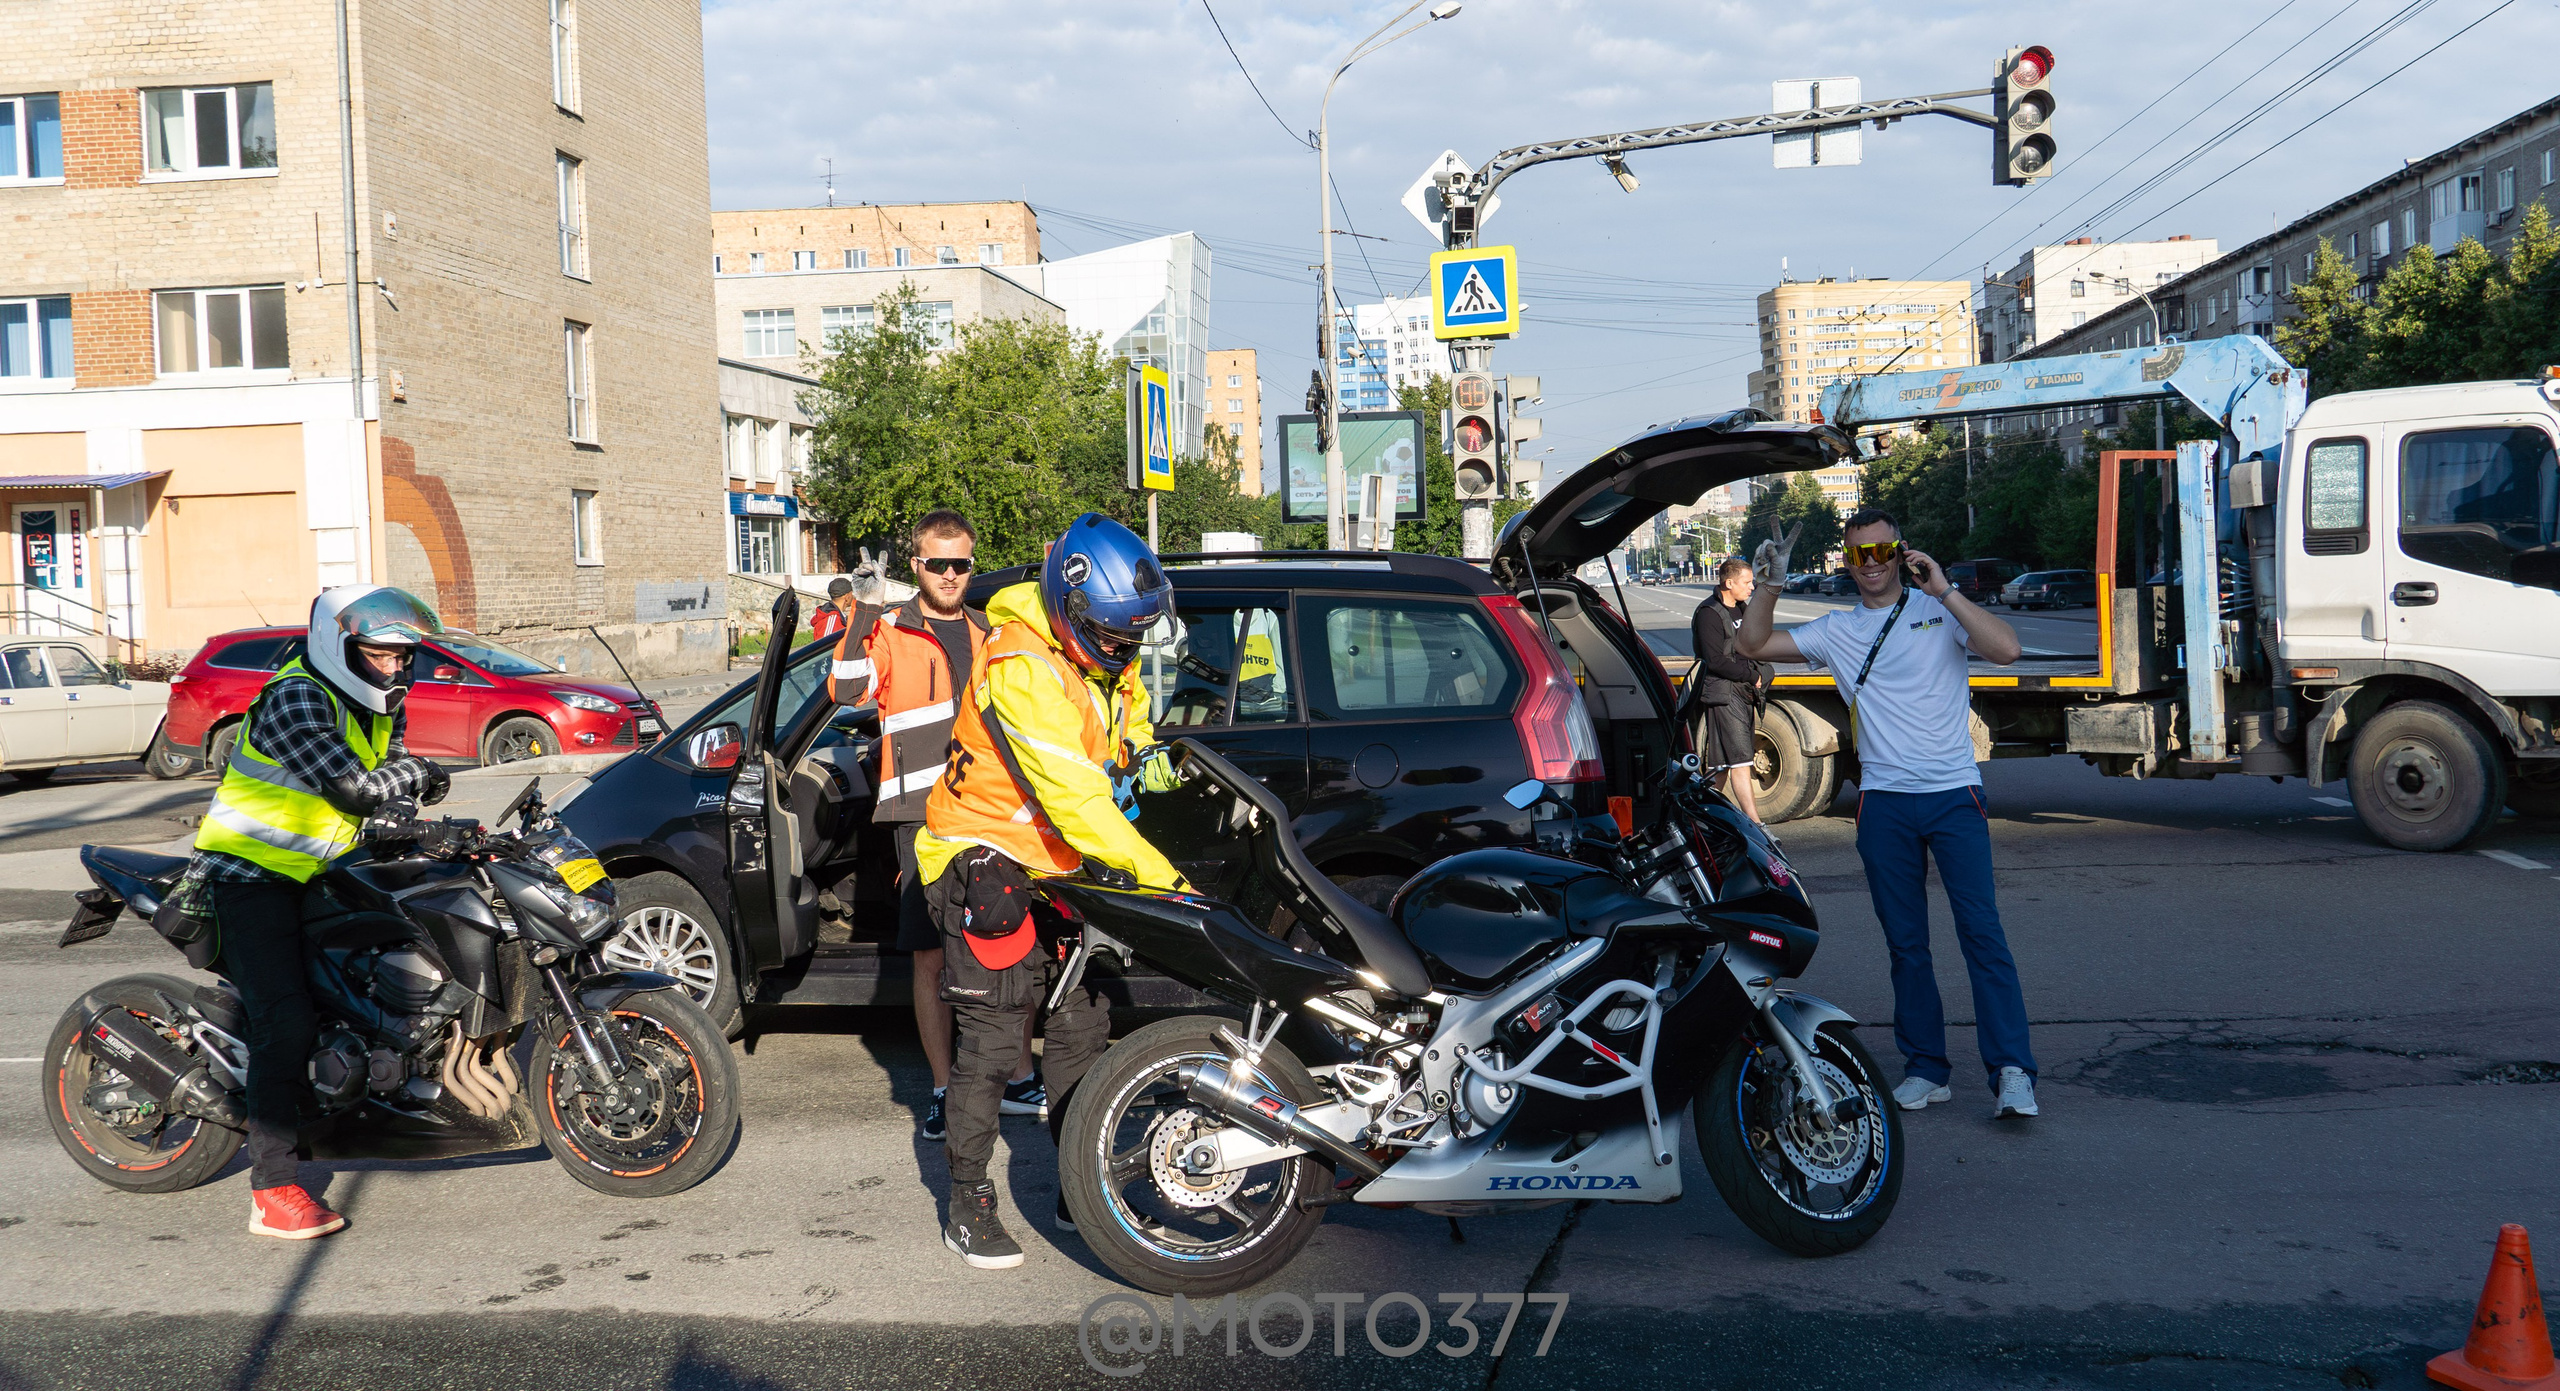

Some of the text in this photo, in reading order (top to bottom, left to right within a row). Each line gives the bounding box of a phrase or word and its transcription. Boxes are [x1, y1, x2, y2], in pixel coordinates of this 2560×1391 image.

[2041, 372, 2082, 385] TADANO
[1899, 387, 1937, 402] SUPER
[1960, 379, 2002, 394] FX300
[1910, 616, 1943, 630] IRON STAR
[1152, 894, 1211, 911] MOTOGYMKHANA
[1751, 932, 1781, 947] MOTUL
[1531, 1001, 1553, 1020] LAVR
[1111, 1079, 1138, 1108] HONDA
[1486, 1176, 1641, 1190] HONDA
[1789, 1199, 1818, 1217] HONDA
[1262, 1206, 1288, 1237] HONDA
